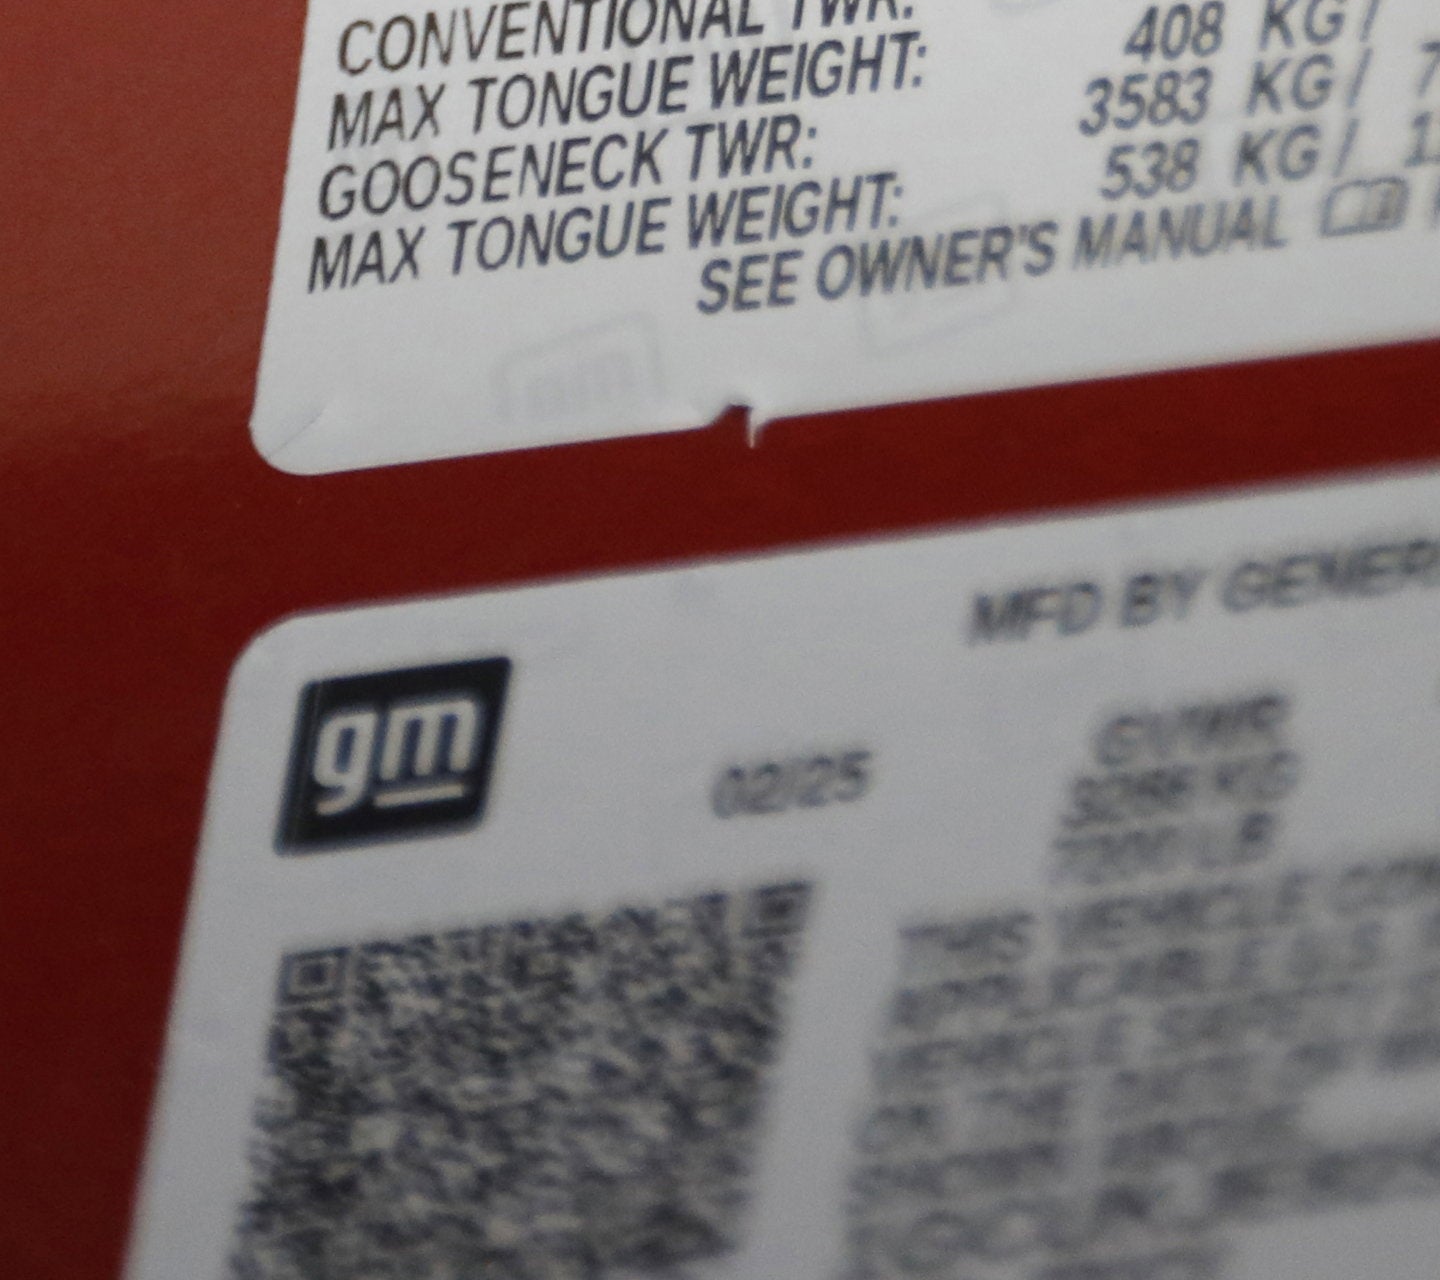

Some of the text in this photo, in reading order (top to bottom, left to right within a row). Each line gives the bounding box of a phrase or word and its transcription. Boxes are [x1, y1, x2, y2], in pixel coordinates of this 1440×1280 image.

[315, 124, 670, 222] GOOSENECK
[682, 110, 818, 183] TWR:
[1075, 62, 1215, 138] 3583
[324, 80, 447, 152] MAX
[465, 51, 695, 135] TONGUE
[707, 27, 928, 111] WEIGHT:
[305, 223, 427, 295] MAX
[444, 193, 673, 277] TONGUE
[684, 168, 903, 250] WEIGHT:
[1097, 133, 1203, 203] 538
[693, 245, 805, 316] SEE
[812, 216, 1060, 302] OWNER'S
[1070, 192, 1288, 268] MANUAL
[969, 578, 1103, 640] MFD
[1118, 568, 1206, 627] BY
[312, 699, 477, 816] gm
[710, 746, 872, 818] 02/25
